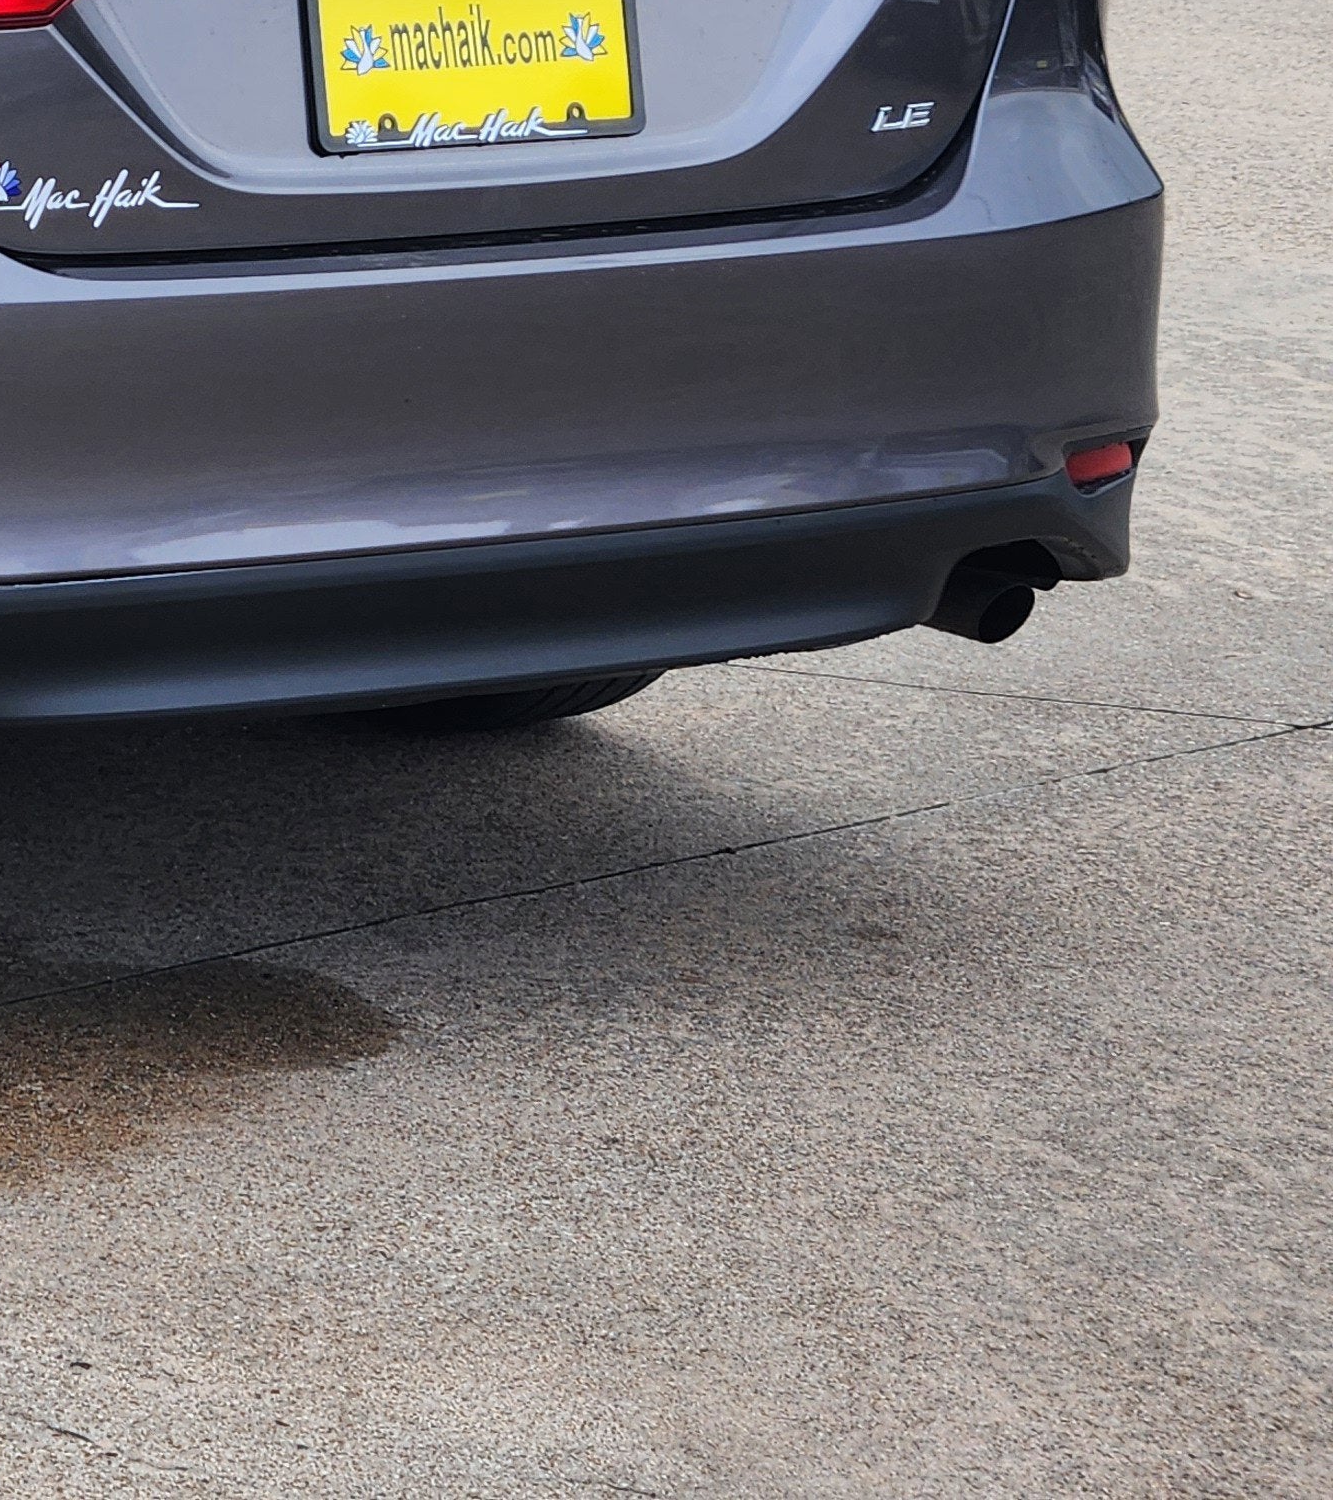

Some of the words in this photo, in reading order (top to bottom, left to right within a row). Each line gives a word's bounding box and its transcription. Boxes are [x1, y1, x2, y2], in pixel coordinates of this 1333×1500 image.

[389, 3, 558, 72] machaik.com
[406, 111, 480, 148] Mac
[479, 106, 547, 143] Haik
[870, 101, 935, 132] LE
[22, 176, 90, 230] Mac
[87, 168, 165, 228] Haik
